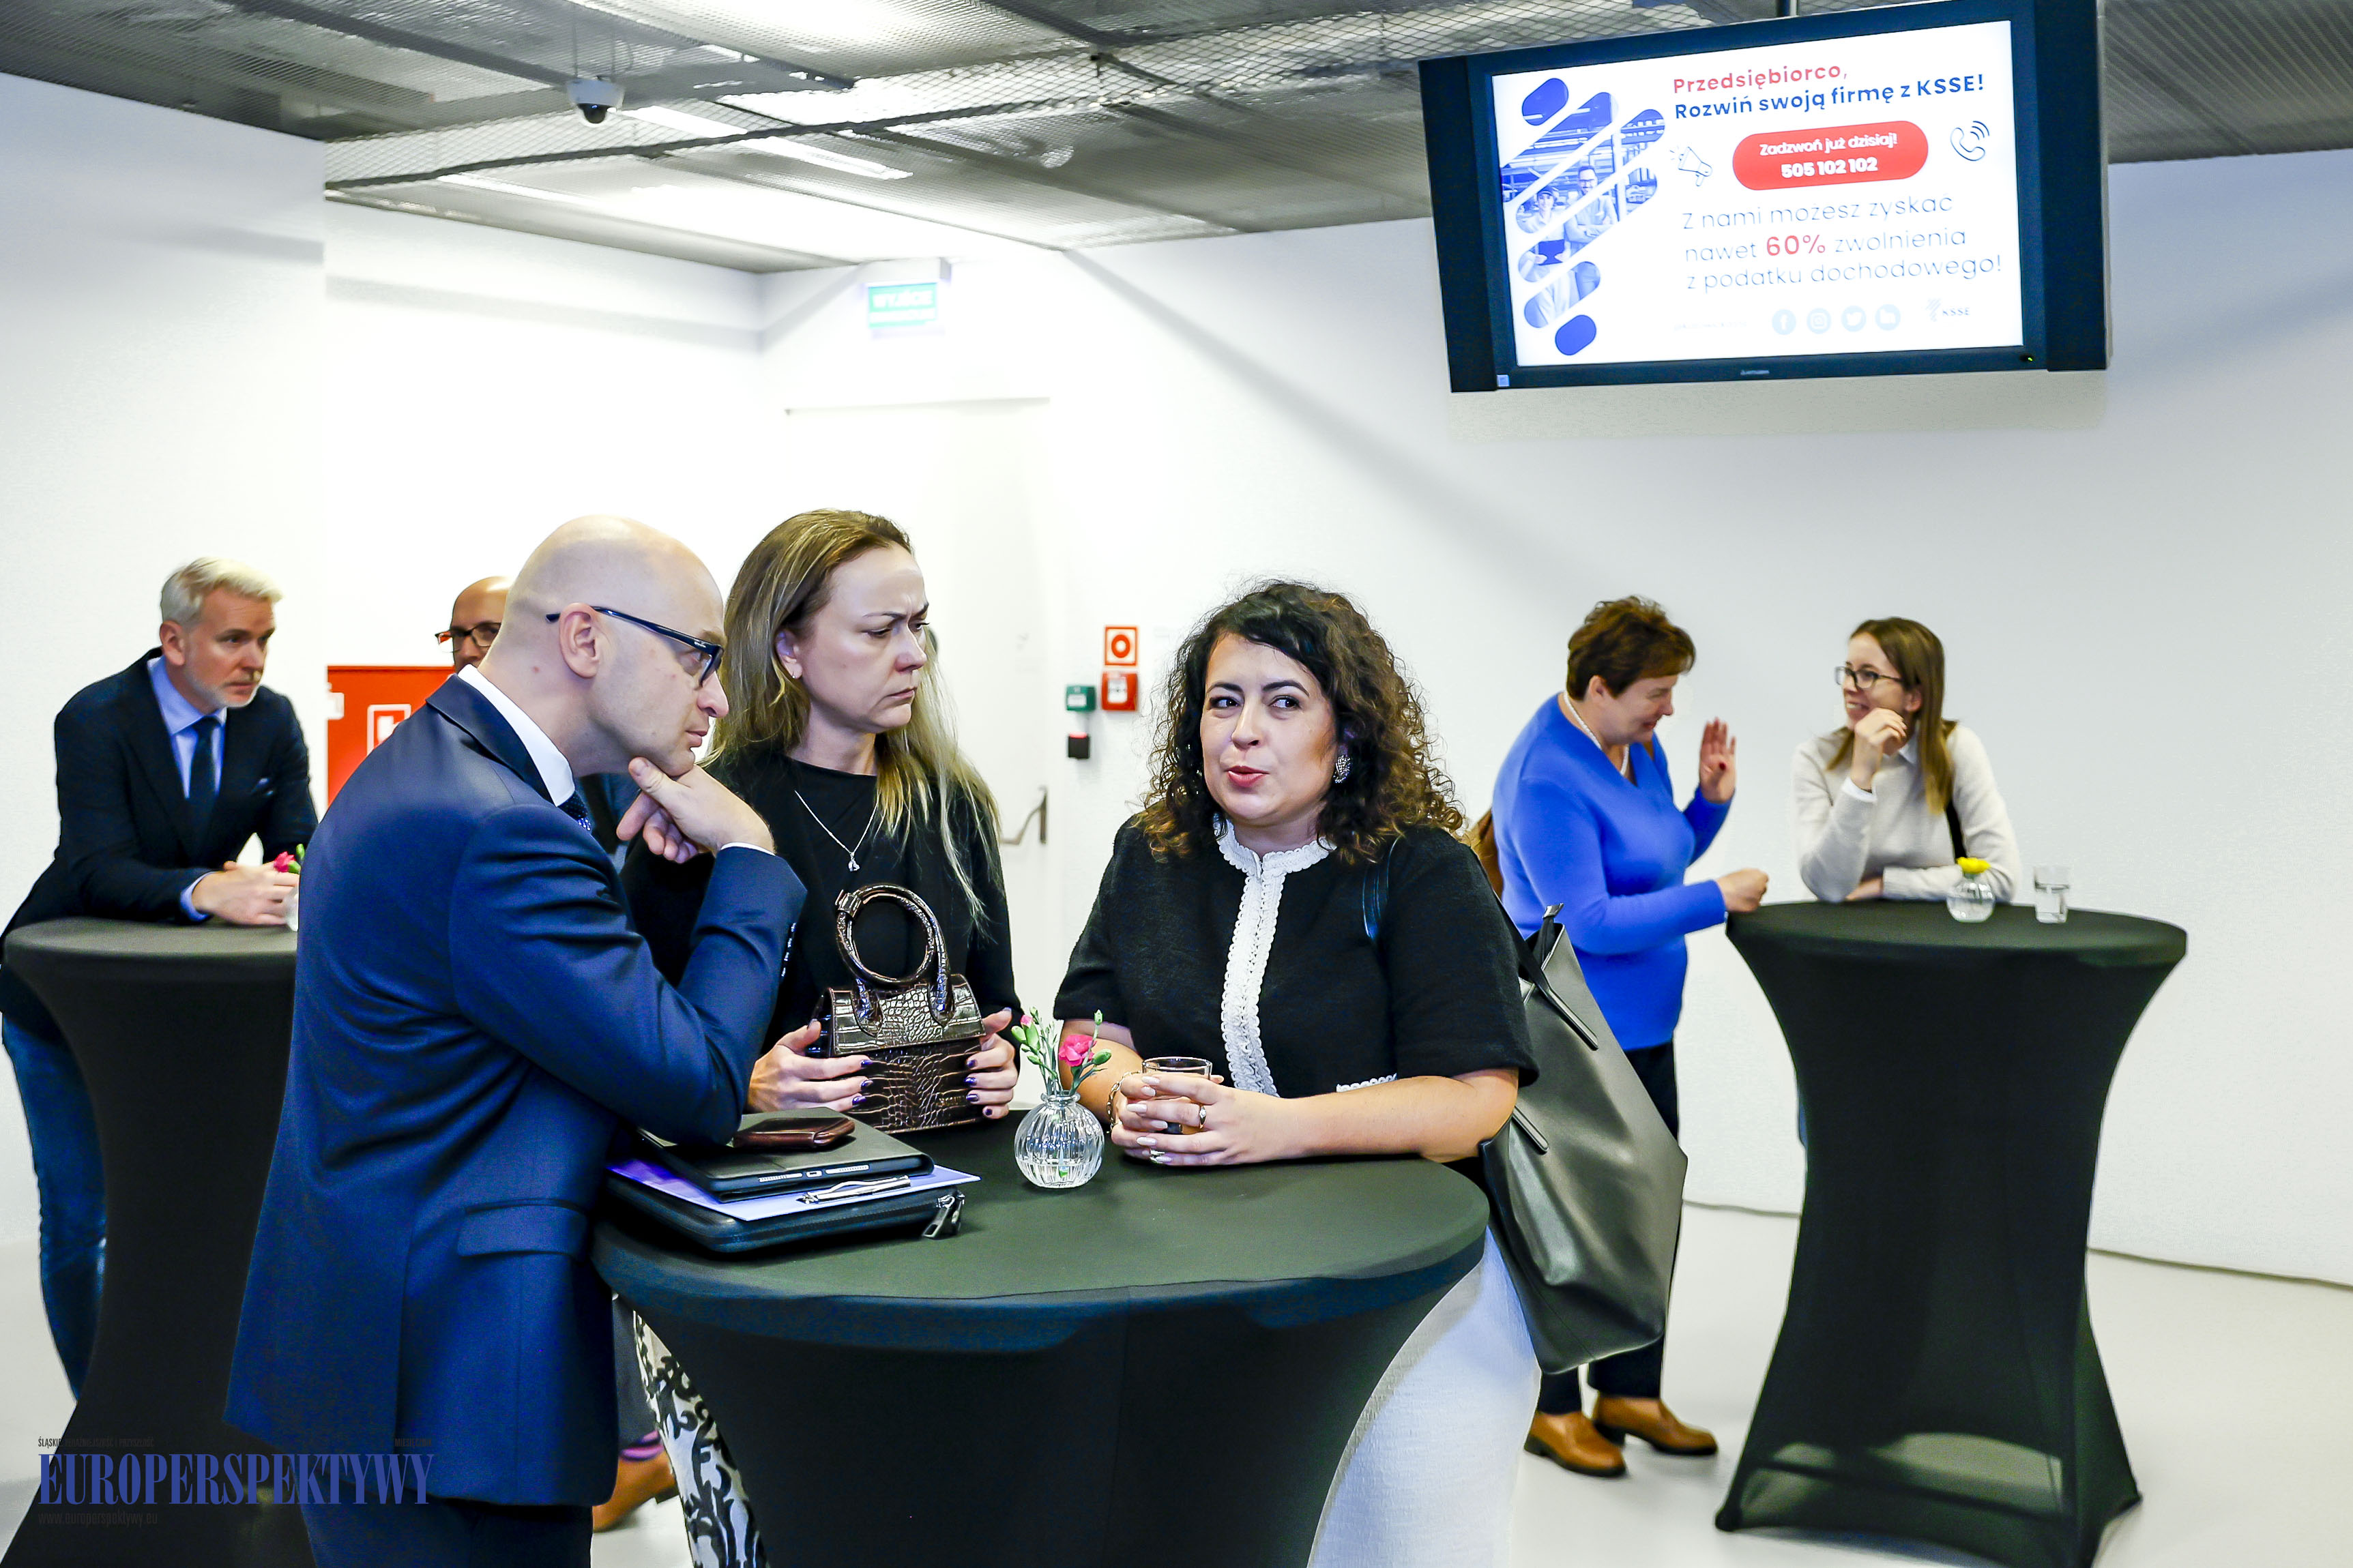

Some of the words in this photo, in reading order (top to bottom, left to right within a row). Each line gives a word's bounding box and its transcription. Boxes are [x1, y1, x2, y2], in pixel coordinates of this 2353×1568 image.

[1674, 65, 1847, 93] Przedsiębiorco,
[1675, 95, 1752, 119] Rozwiń
[1759, 89, 1825, 113] swoją
[1831, 86, 1894, 104] firmę
[1900, 85, 1911, 98] z
[1917, 74, 1983, 96] KSSE!
[1759, 138, 1823, 156] Zadzwoń
[1824, 137, 1846, 153] już
[1847, 132, 1898, 149] dzisiaj!
[1781, 162, 1815, 179] 505
[1817, 159, 1847, 176] 102
[1848, 156, 1878, 173] 102
[1682, 213, 1693, 229] Z
[1702, 207, 1762, 228] nami
[1686, 242, 1757, 262] nawet
[1766, 234, 1826, 256] 60%
[1835, 227, 1965, 252] zwolnienia
[1687, 276, 1696, 289] z
[1704, 267, 1802, 294] podatku
[1811, 254, 2001, 282] dochodowego!
